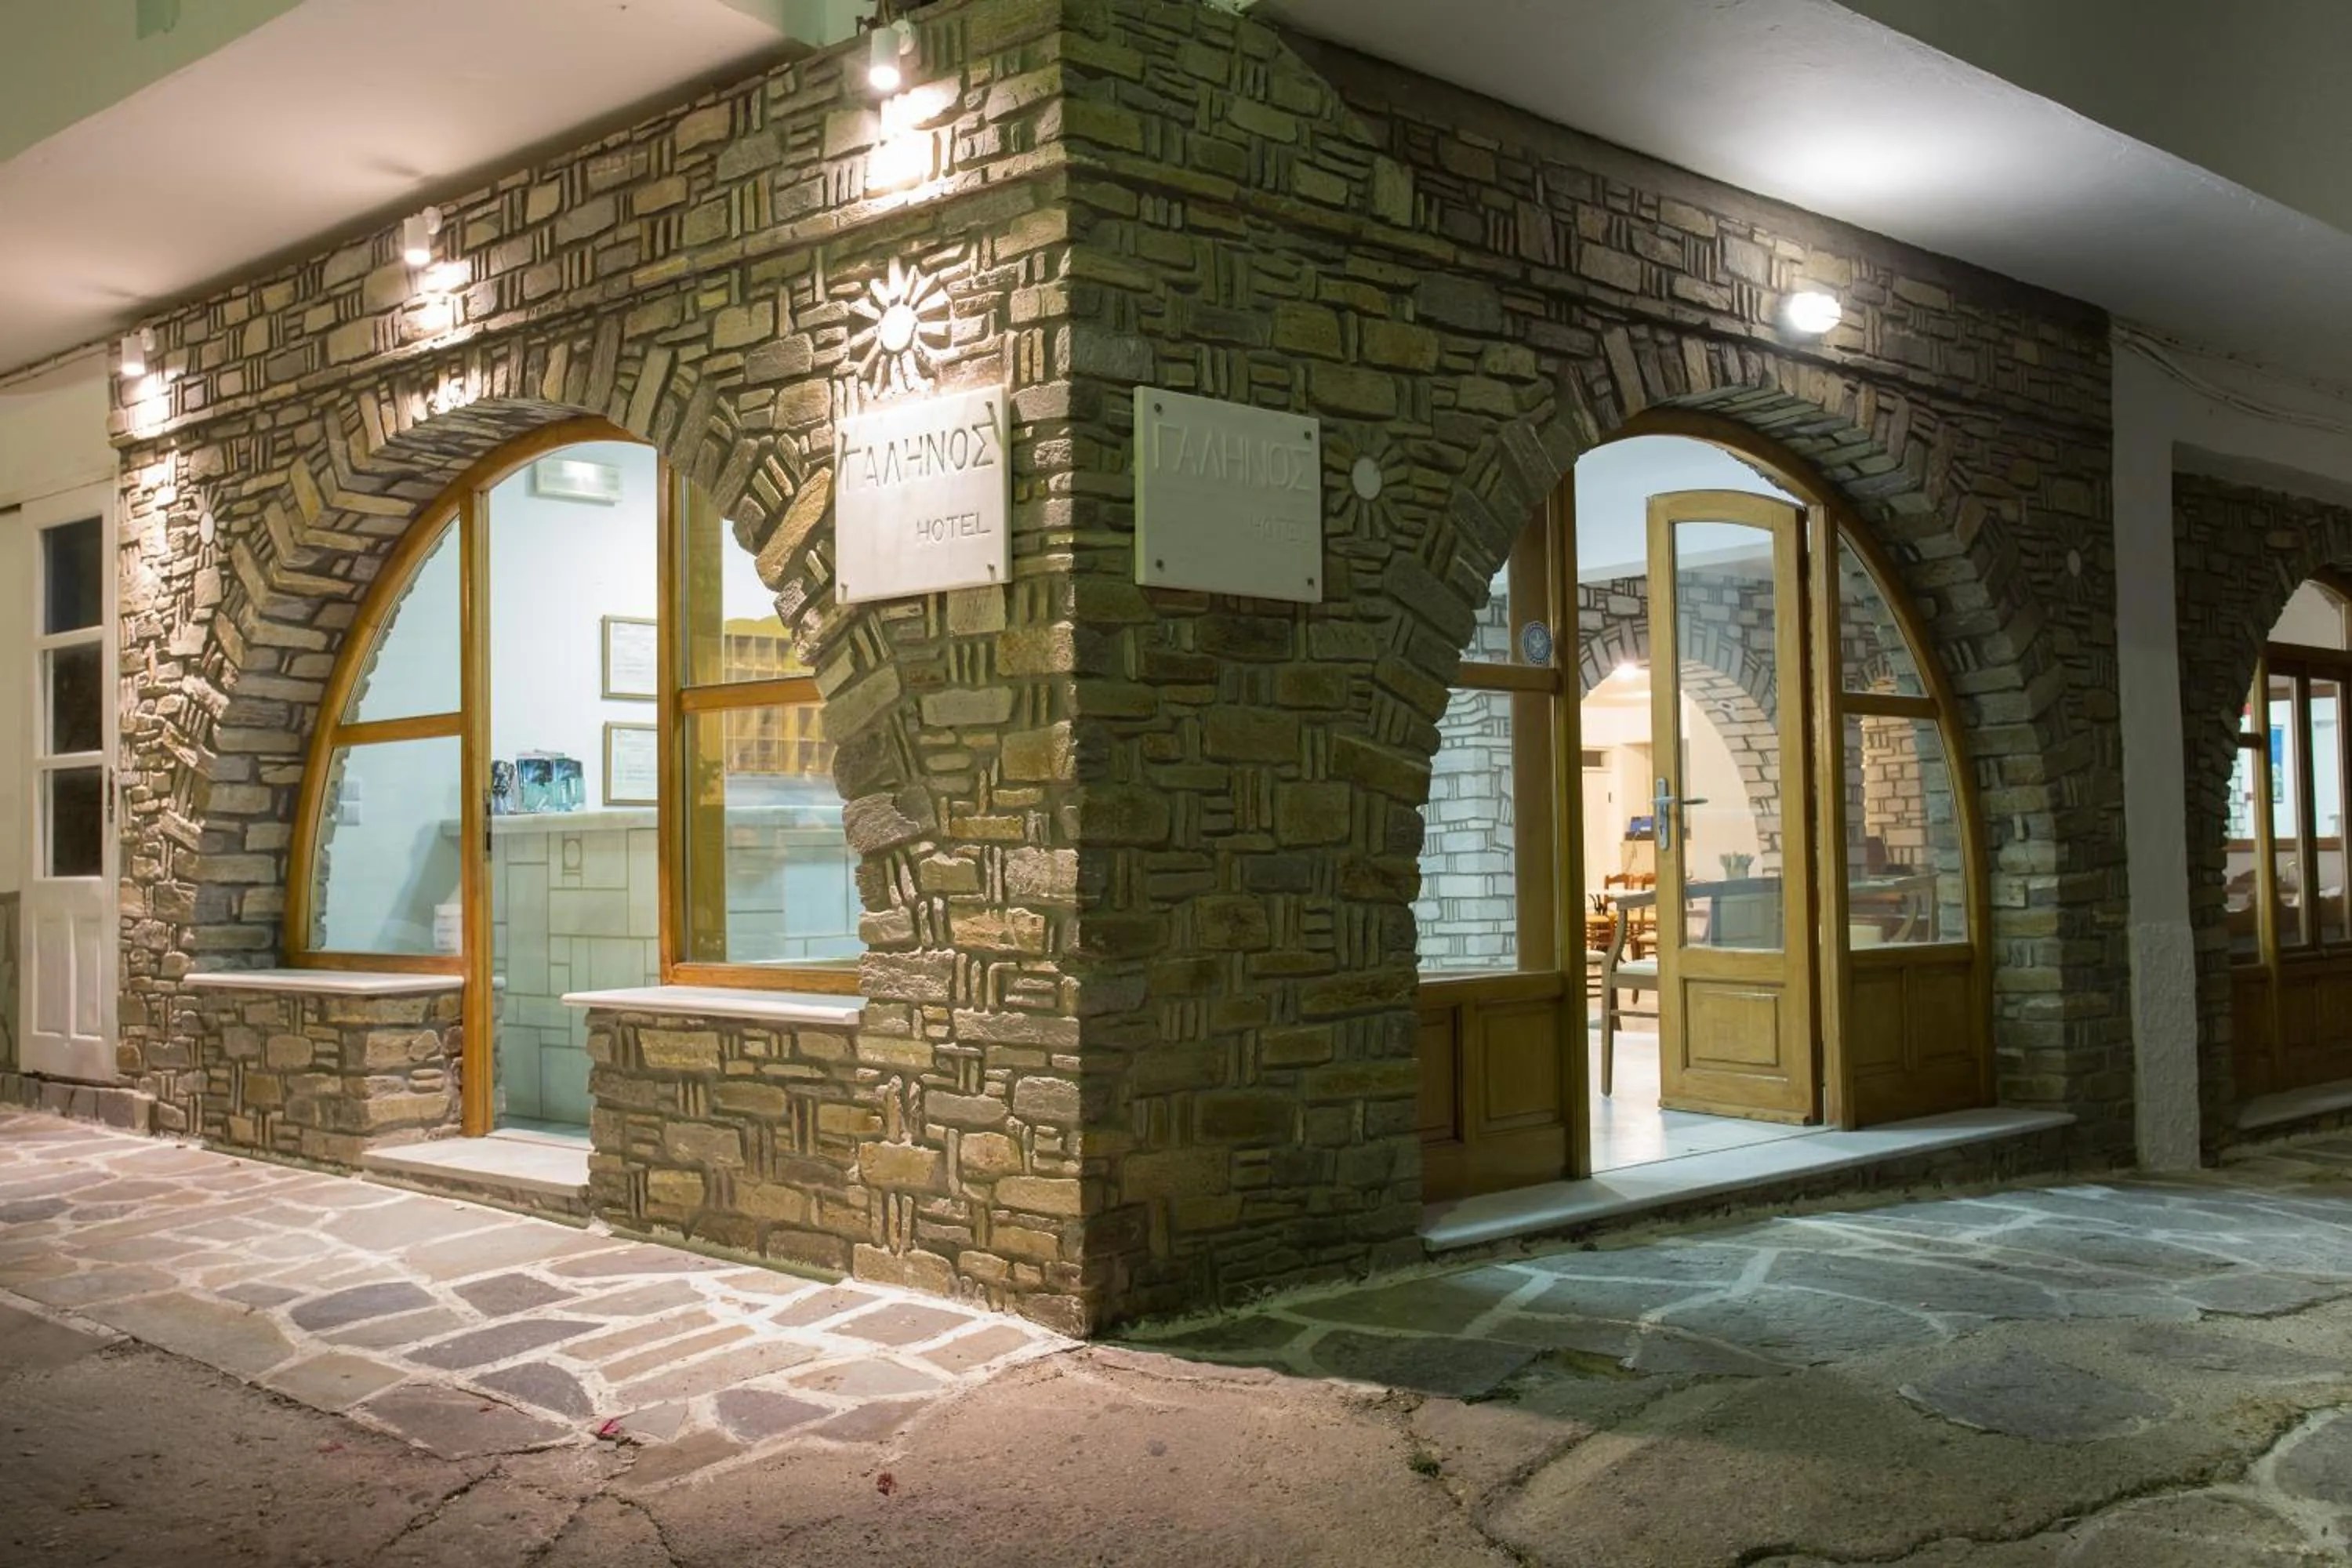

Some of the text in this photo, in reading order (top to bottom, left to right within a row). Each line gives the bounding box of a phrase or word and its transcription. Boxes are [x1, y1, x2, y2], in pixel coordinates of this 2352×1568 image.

[842, 422, 994, 492] ΓΑΛΗΝΟΣ
[1153, 421, 1312, 492] ΓΑΛΗΝΟΣ
[916, 512, 992, 543] HOTEL
